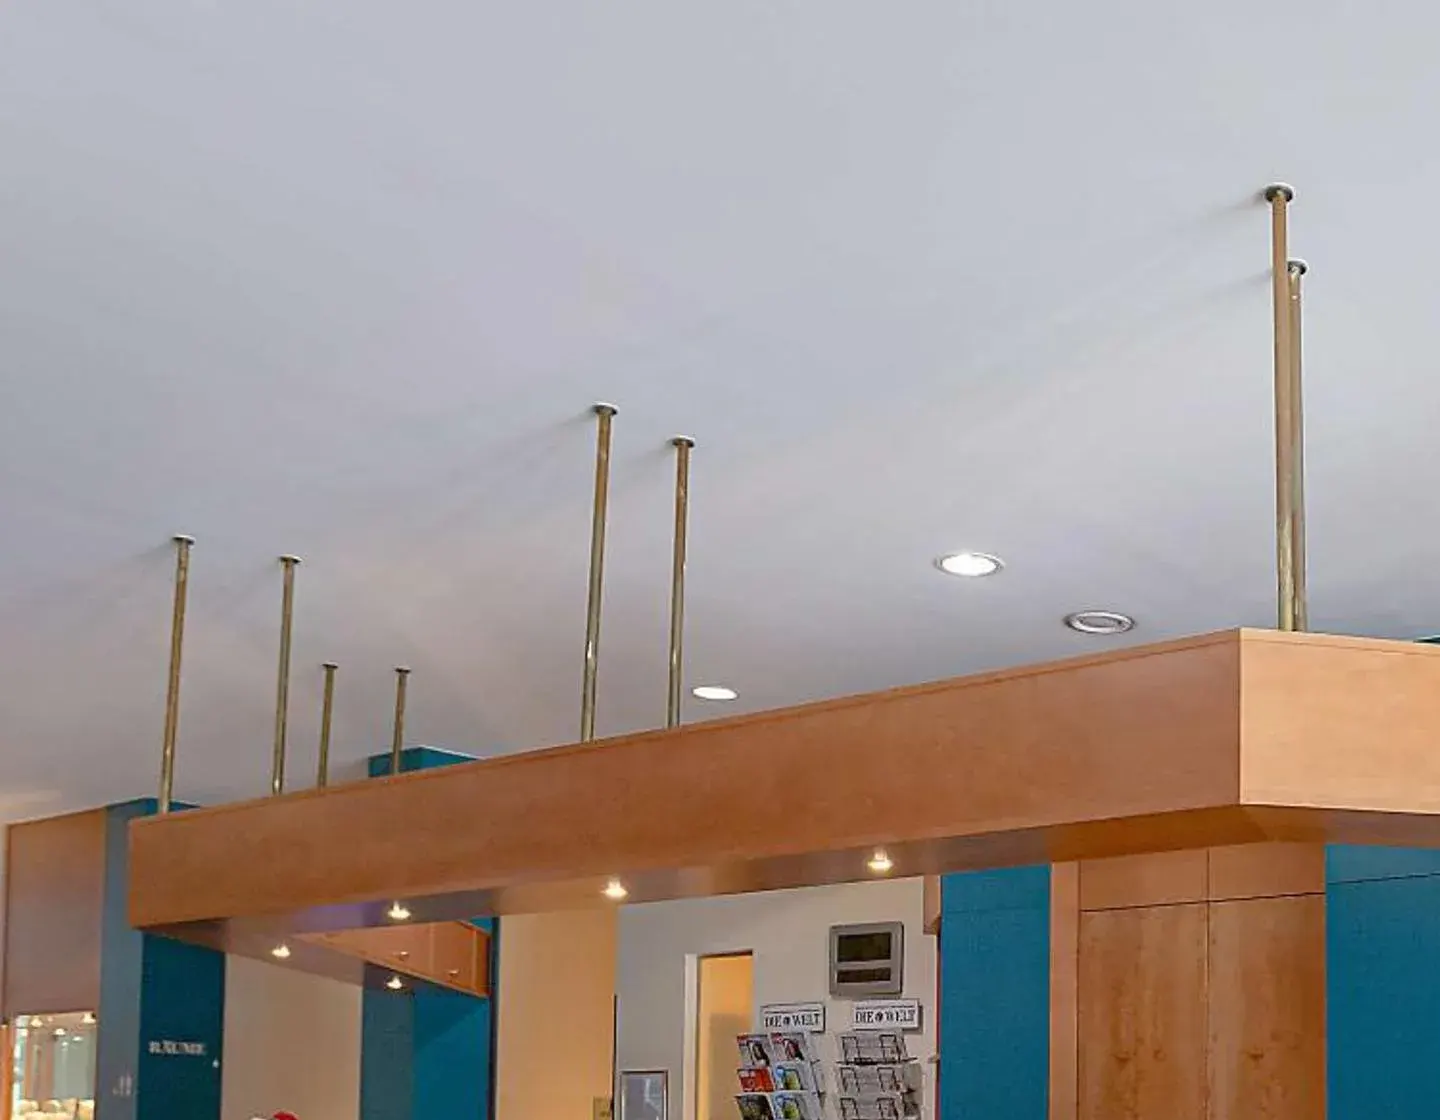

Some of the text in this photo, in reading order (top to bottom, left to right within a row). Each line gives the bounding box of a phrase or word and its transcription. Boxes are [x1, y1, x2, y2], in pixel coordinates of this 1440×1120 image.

[765, 1013, 820, 1028] DIE WELT
[855, 1009, 915, 1024] DIE WELT
